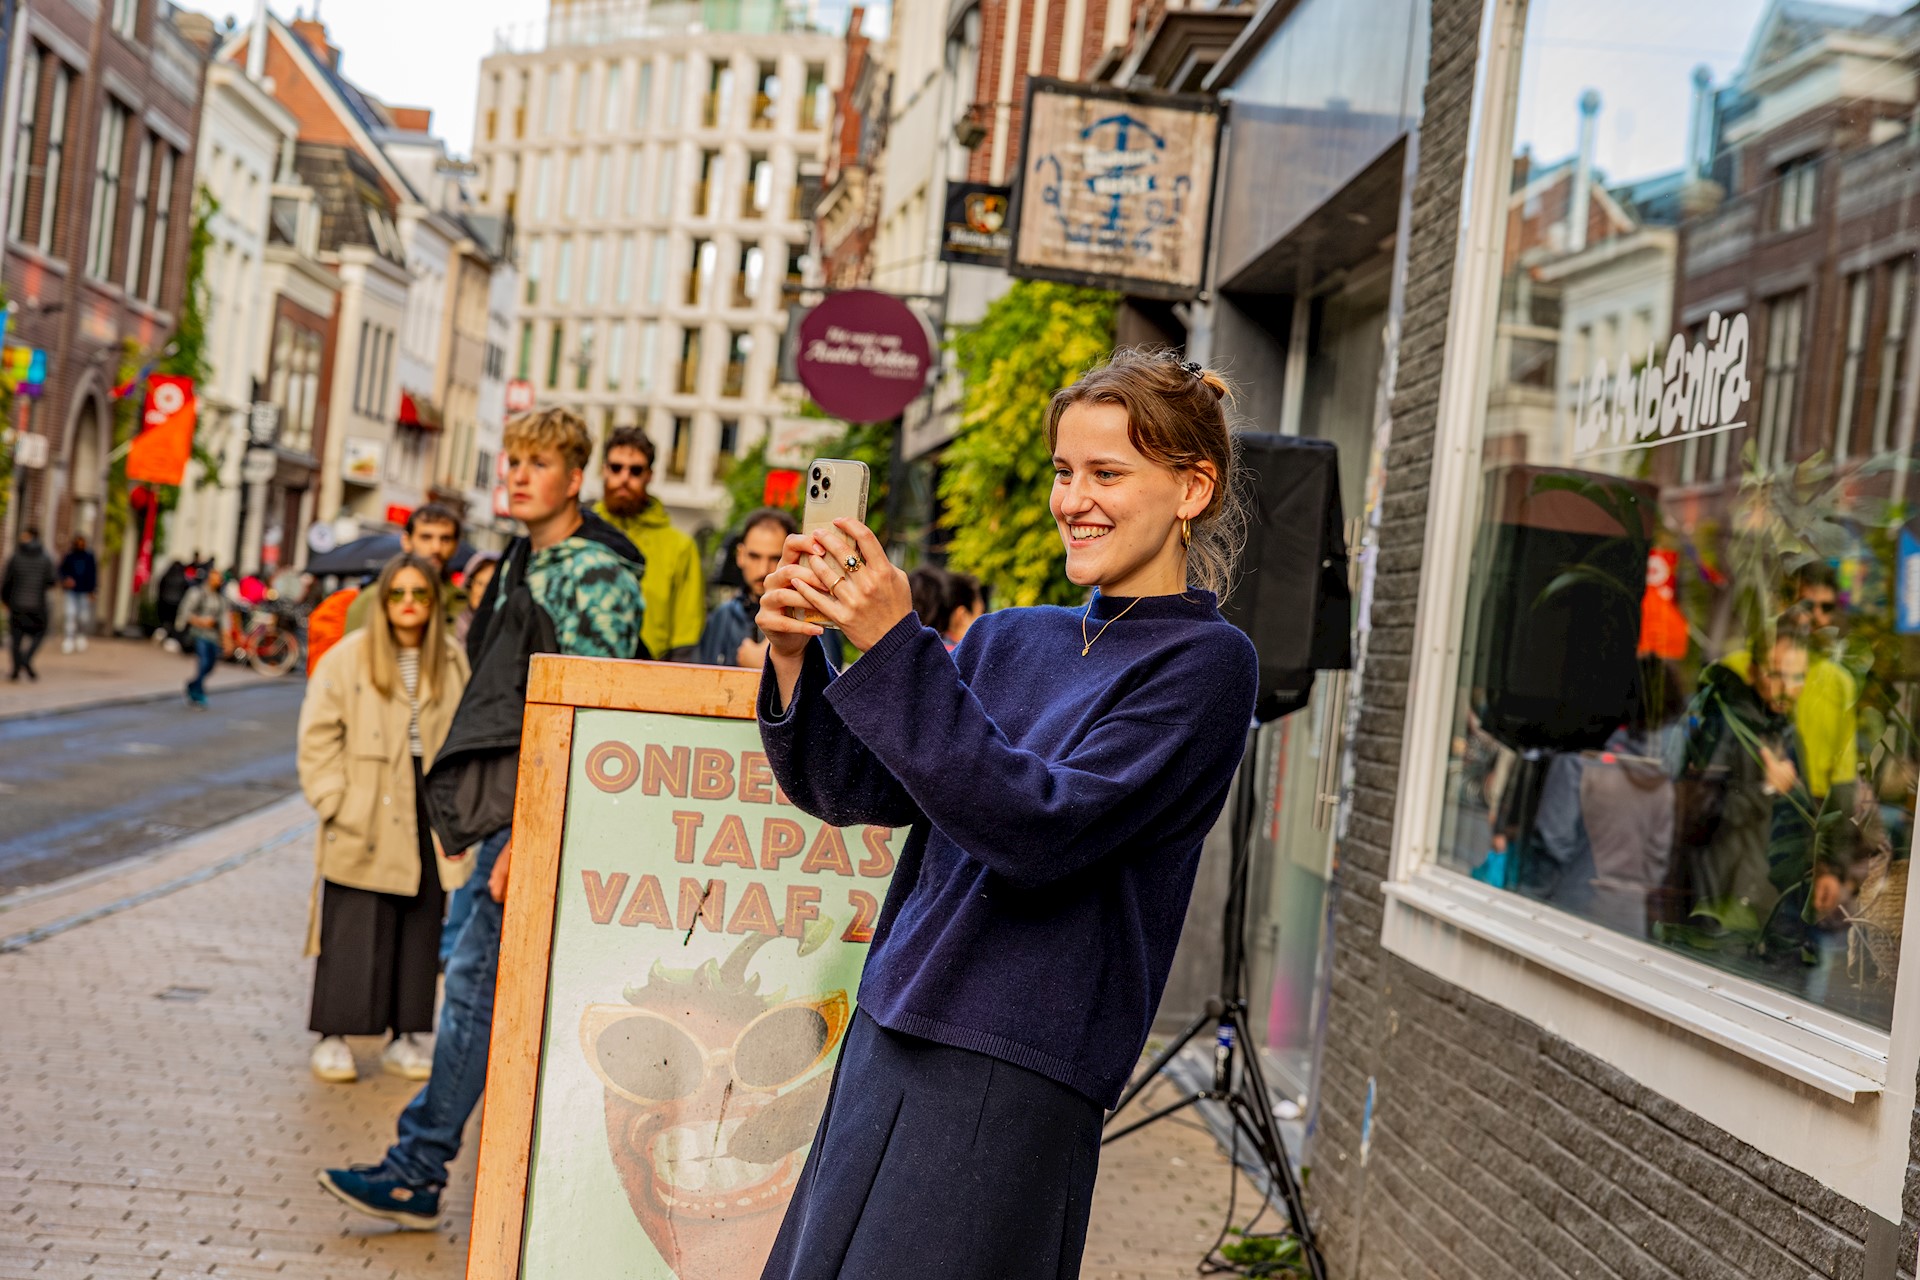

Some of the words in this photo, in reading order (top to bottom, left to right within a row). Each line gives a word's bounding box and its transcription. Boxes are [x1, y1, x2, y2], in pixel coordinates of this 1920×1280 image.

[585, 740, 795, 806] ONBE
[672, 810, 895, 878] TAPAS
[581, 869, 822, 939] VANAF
